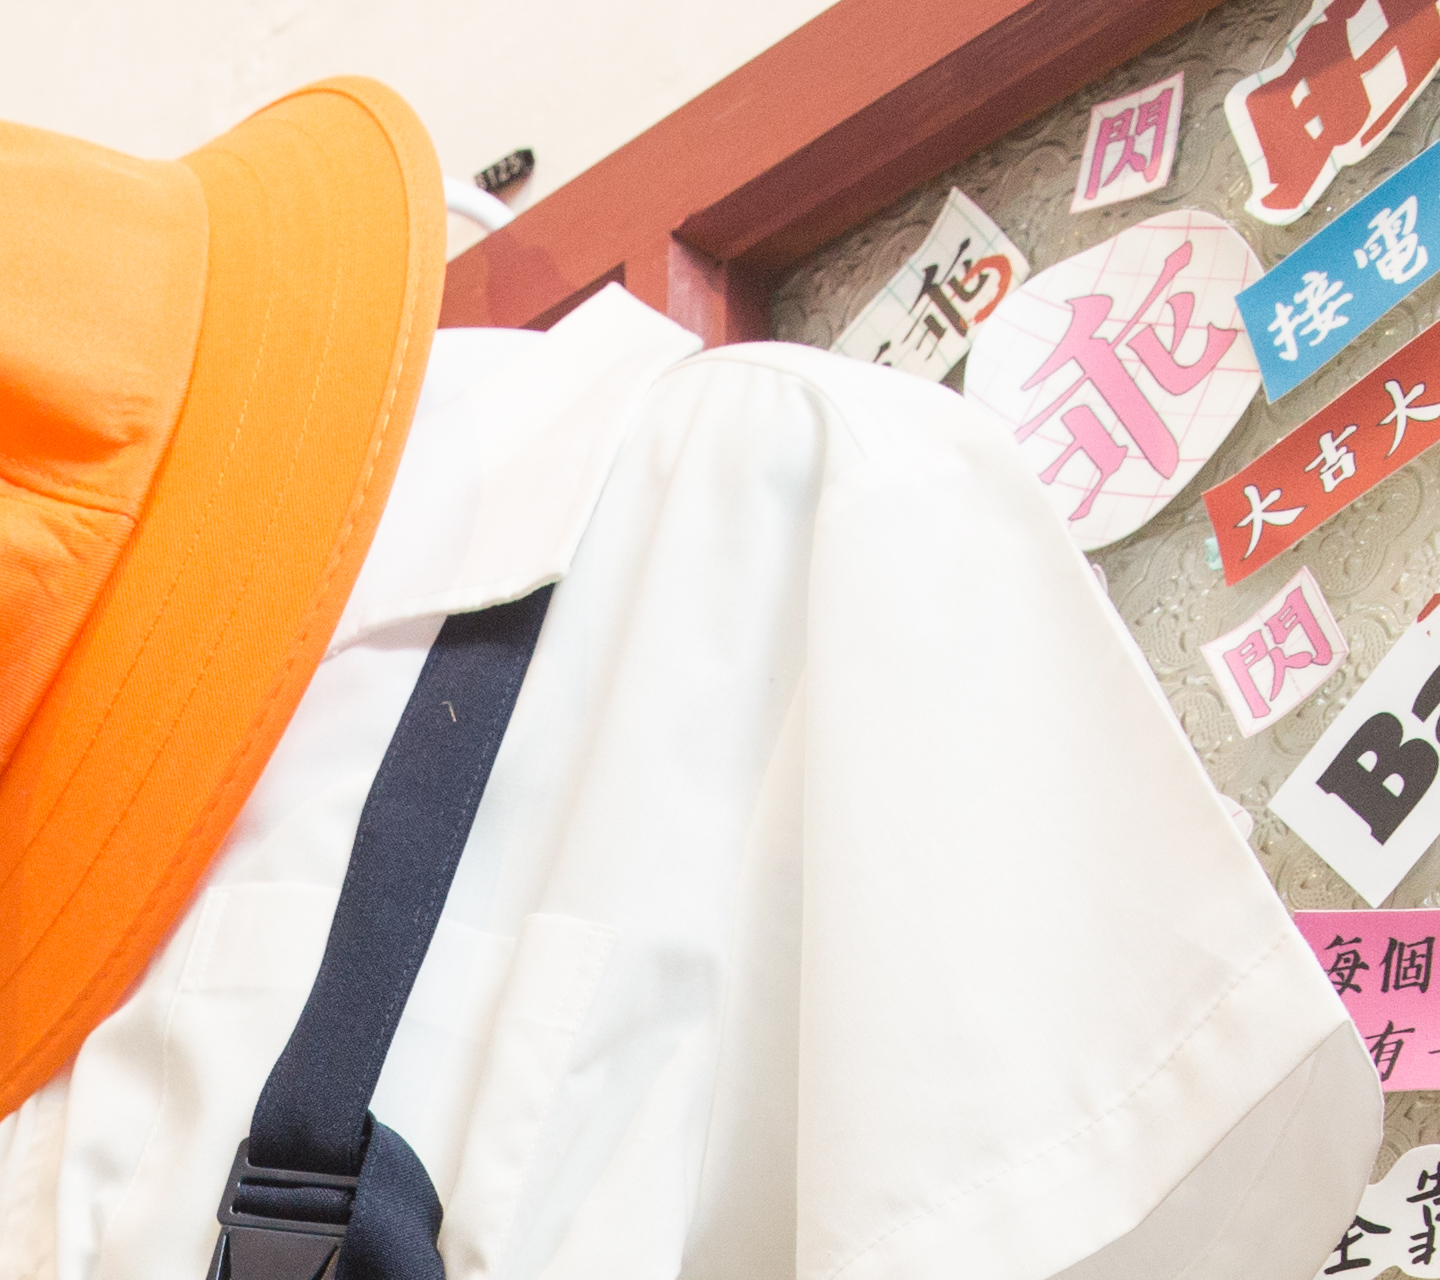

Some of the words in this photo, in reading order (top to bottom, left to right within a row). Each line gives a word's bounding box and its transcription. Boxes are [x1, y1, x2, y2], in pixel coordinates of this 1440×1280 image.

[1084, 86, 1174, 200] 閃
[1014, 240, 1237, 521] 乖
[1223, 586, 1333, 719] 閃
